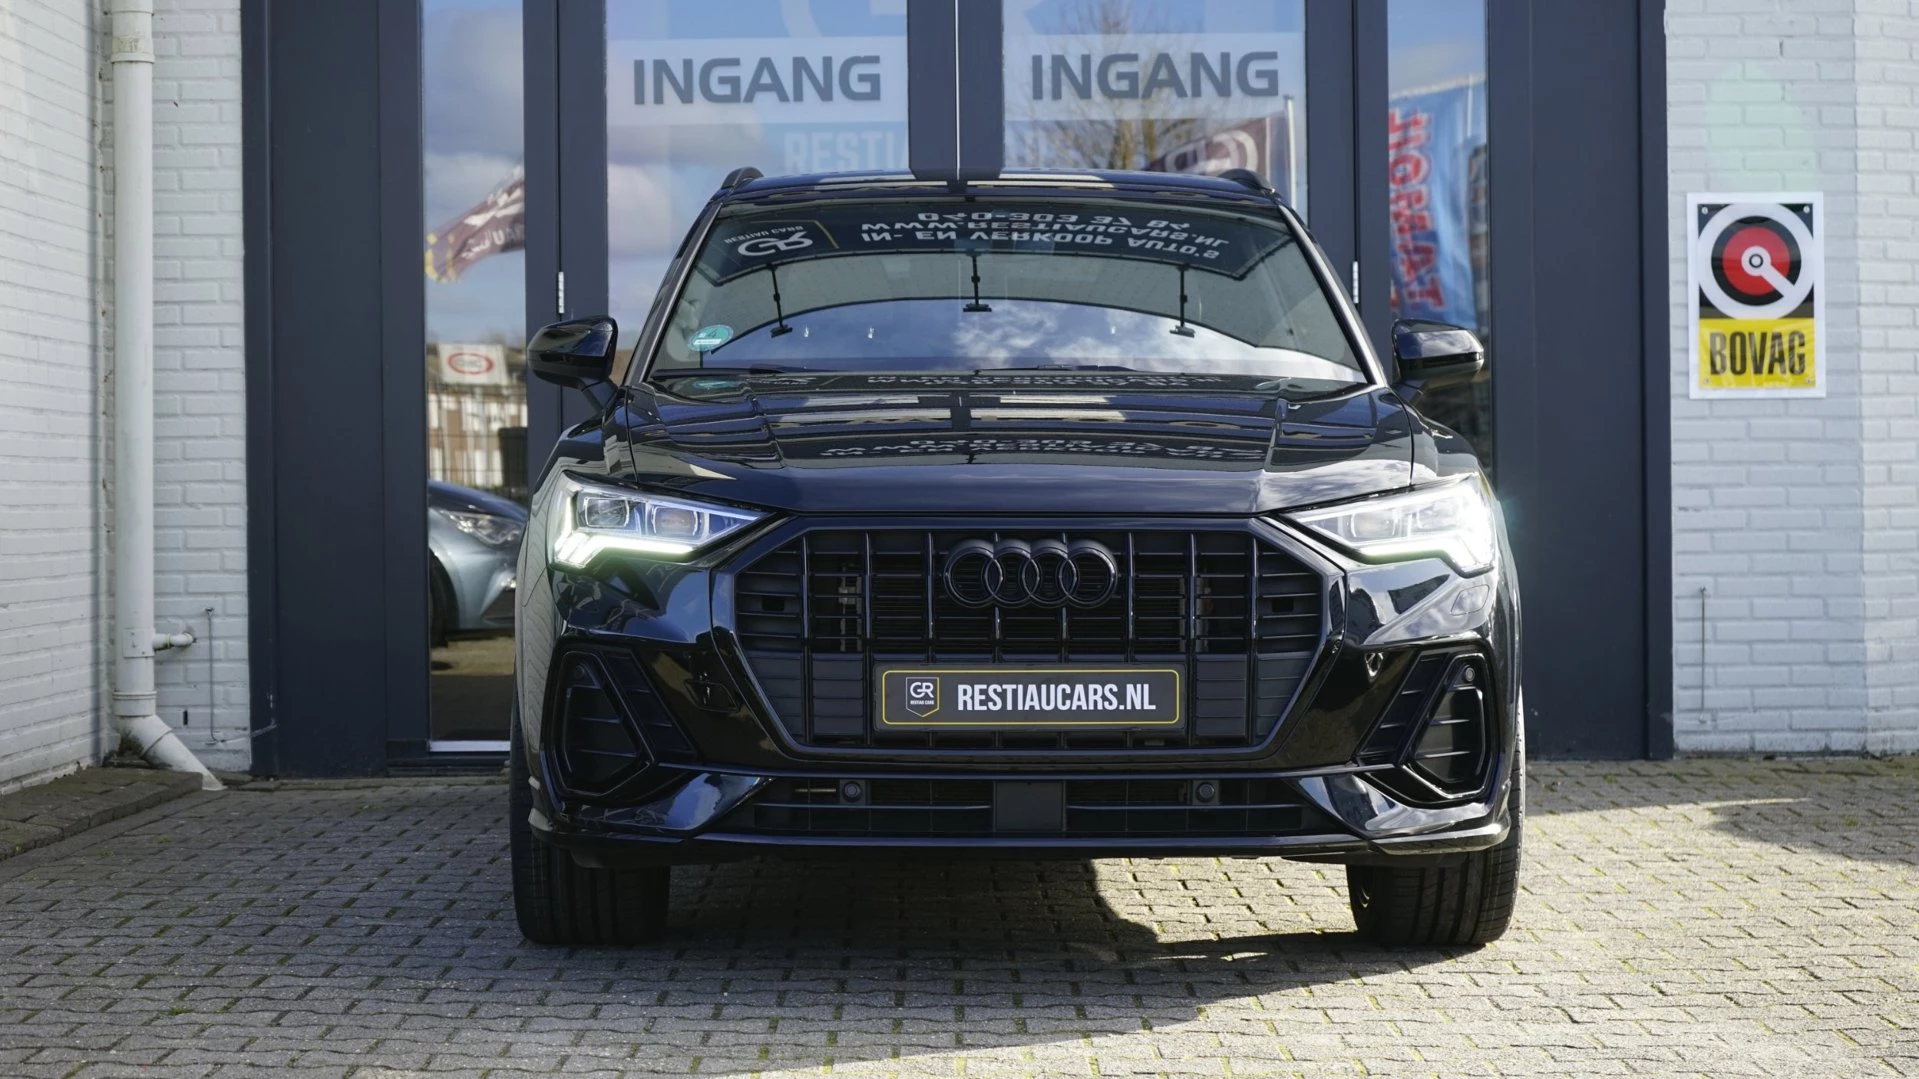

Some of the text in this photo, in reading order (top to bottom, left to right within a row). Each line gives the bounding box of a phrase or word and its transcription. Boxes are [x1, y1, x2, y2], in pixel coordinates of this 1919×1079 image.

[633, 55, 882, 105] INGANG
[1031, 51, 1279, 100] INGANG
[784, 131, 908, 174] RESTI
[1709, 330, 1806, 376] BOVAG
[910, 681, 934, 698] GR
[957, 683, 1156, 711] RESTIAUCARS.NL
